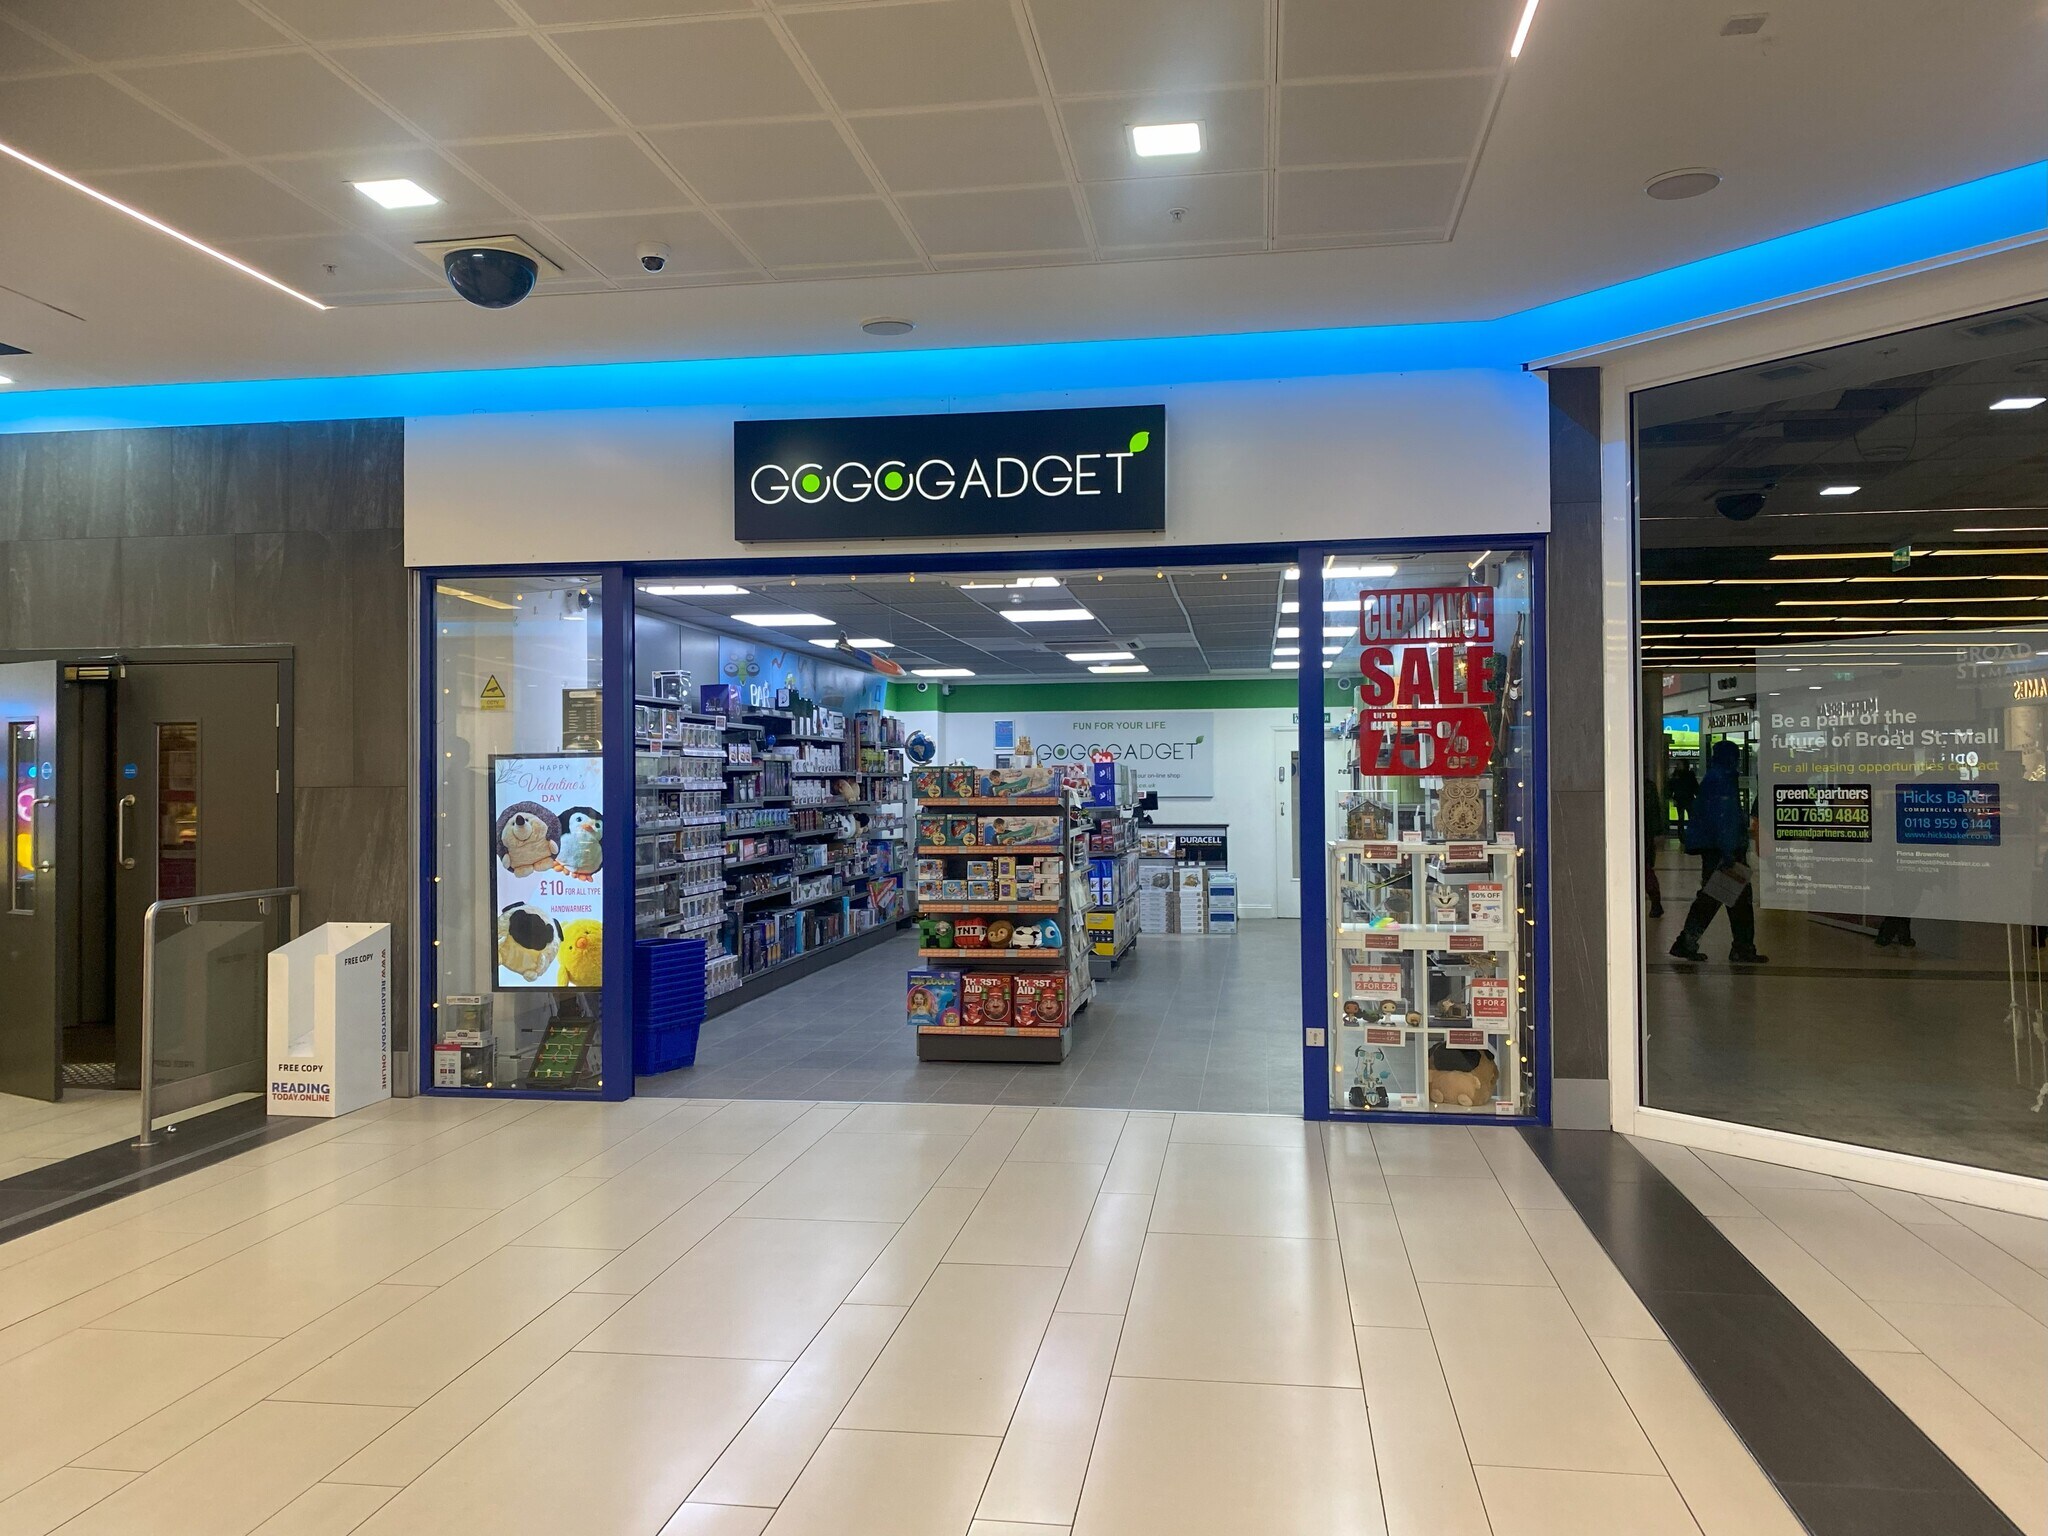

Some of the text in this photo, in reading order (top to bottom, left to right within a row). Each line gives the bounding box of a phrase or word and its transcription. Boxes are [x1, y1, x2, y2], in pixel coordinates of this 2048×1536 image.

[751, 452, 1134, 504] GOGOGADGET
[1364, 592, 1490, 641] CLEARANCE
[1957, 642, 2032, 663] BROAD
[1360, 645, 1496, 707] SALE
[1073, 721, 1166, 730] FUN FOR YOUR LIFE
[1771, 709, 1917, 730] Be a part of the
[1370, 720, 1470, 769] 75%
[1771, 728, 1999, 749] future of Broad St. Mall
[1447, 755, 1478, 769] OFF
[1773, 763, 1791, 773] For
[1796, 762, 1808, 773] all
[1812, 762, 1854, 774] leasing
[1858, 761, 1944, 775] opportunities
[518, 772, 586, 792] Valentine's
[1167, 772, 1181, 780] shop
[541, 794, 562, 802] DAY
[1776, 786, 1869, 802] green&partners
[1903, 790, 1990, 804] Hicks Baker
[1776, 808, 1869, 823] 020 7659 4848
[1904, 817, 1992, 829] 0118 959 6144
[1776, 828, 1869, 839] greenandpartners.co.uk
[1904, 831, 1993, 840] www.hicksbaker.co.uk
[1179, 836, 1222, 845] DURACELL
[540, 880, 563, 896] £10
[565, 887, 576, 895] FOR
[577, 887, 586, 895] ALL
[550, 904, 592, 913] HANDWARMERS
[957, 927, 977, 935] TNT
[344, 953, 374, 966] FREE COPY
[964, 985, 982, 994] AID
[1017, 986, 1035, 995] AID
[1363, 982, 1380, 990] FOR
[301, 1064, 323, 1072] COPY
[272, 1082, 330, 1094] READING
[272, 1093, 330, 1102] TODAY.ONLINE
